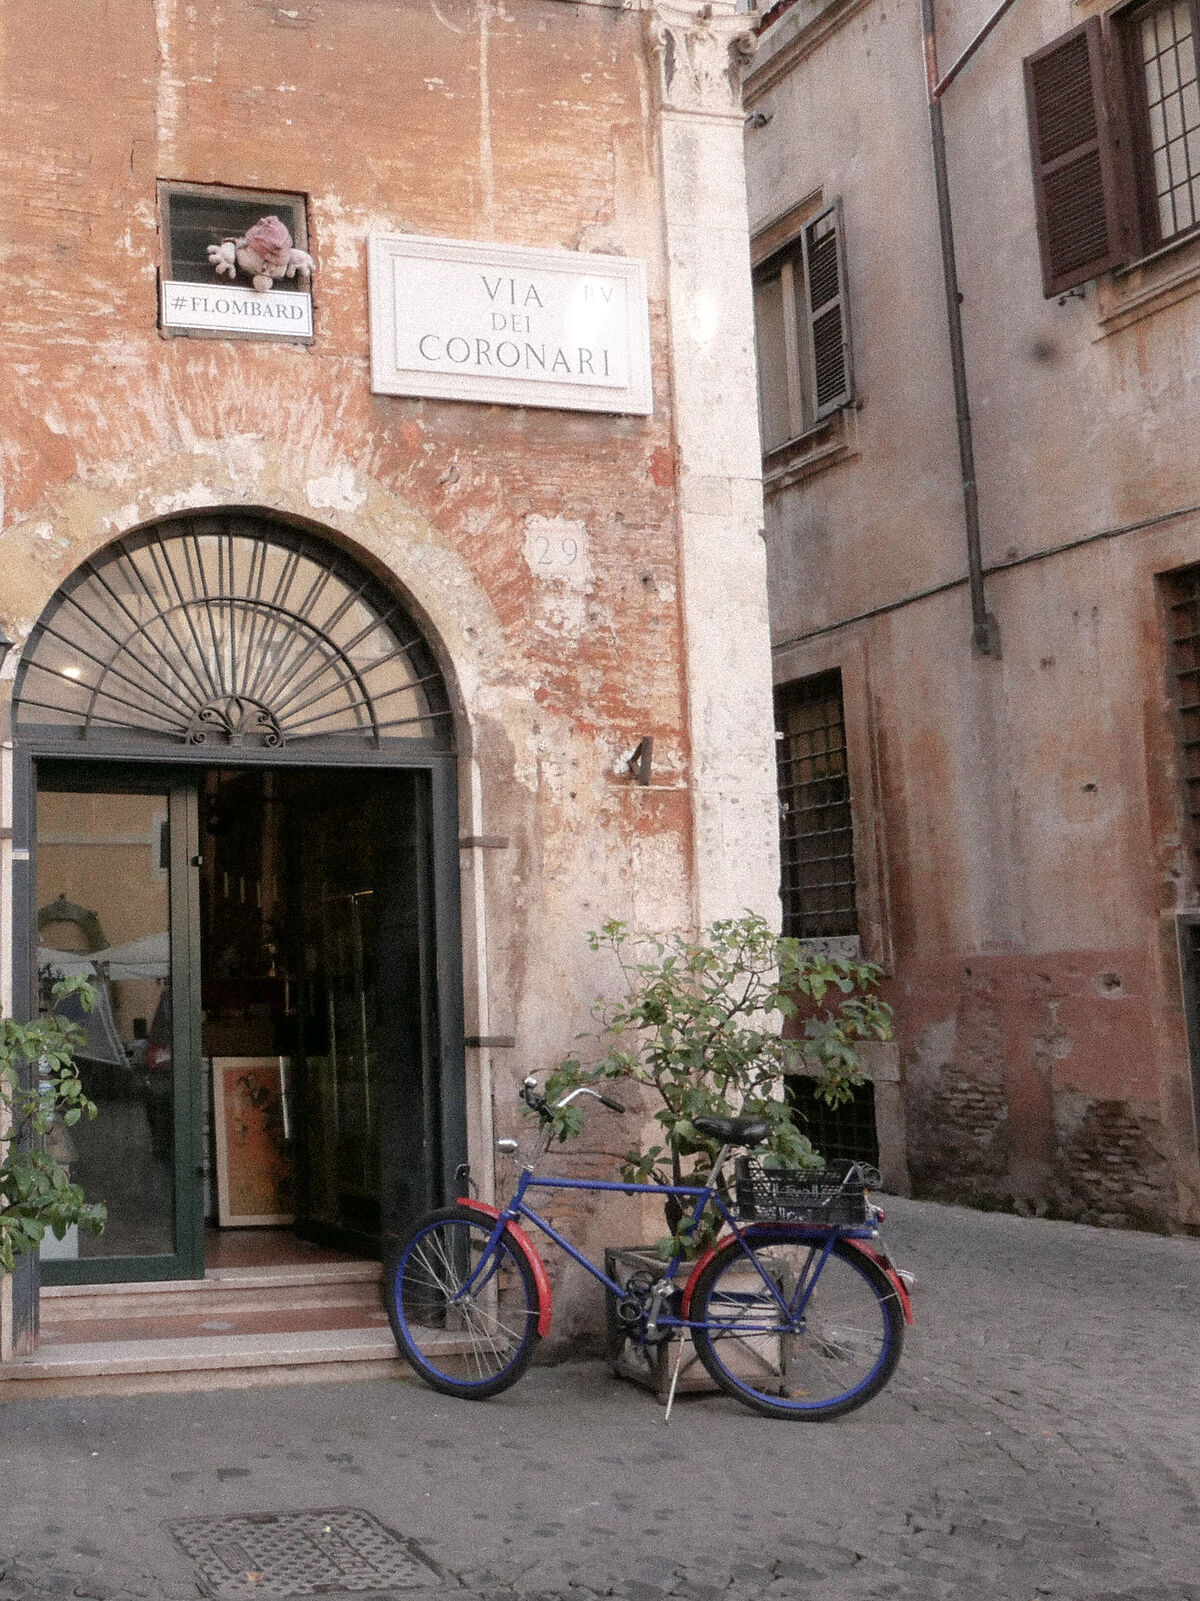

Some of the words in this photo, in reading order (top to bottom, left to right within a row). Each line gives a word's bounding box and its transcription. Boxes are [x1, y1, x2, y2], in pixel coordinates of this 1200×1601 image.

[481, 275, 544, 308] VIA
[171, 295, 303, 320] #FLOMBARD
[491, 311, 530, 334] DEI
[418, 334, 609, 377] CORONARI
[534, 535, 578, 565] 29
